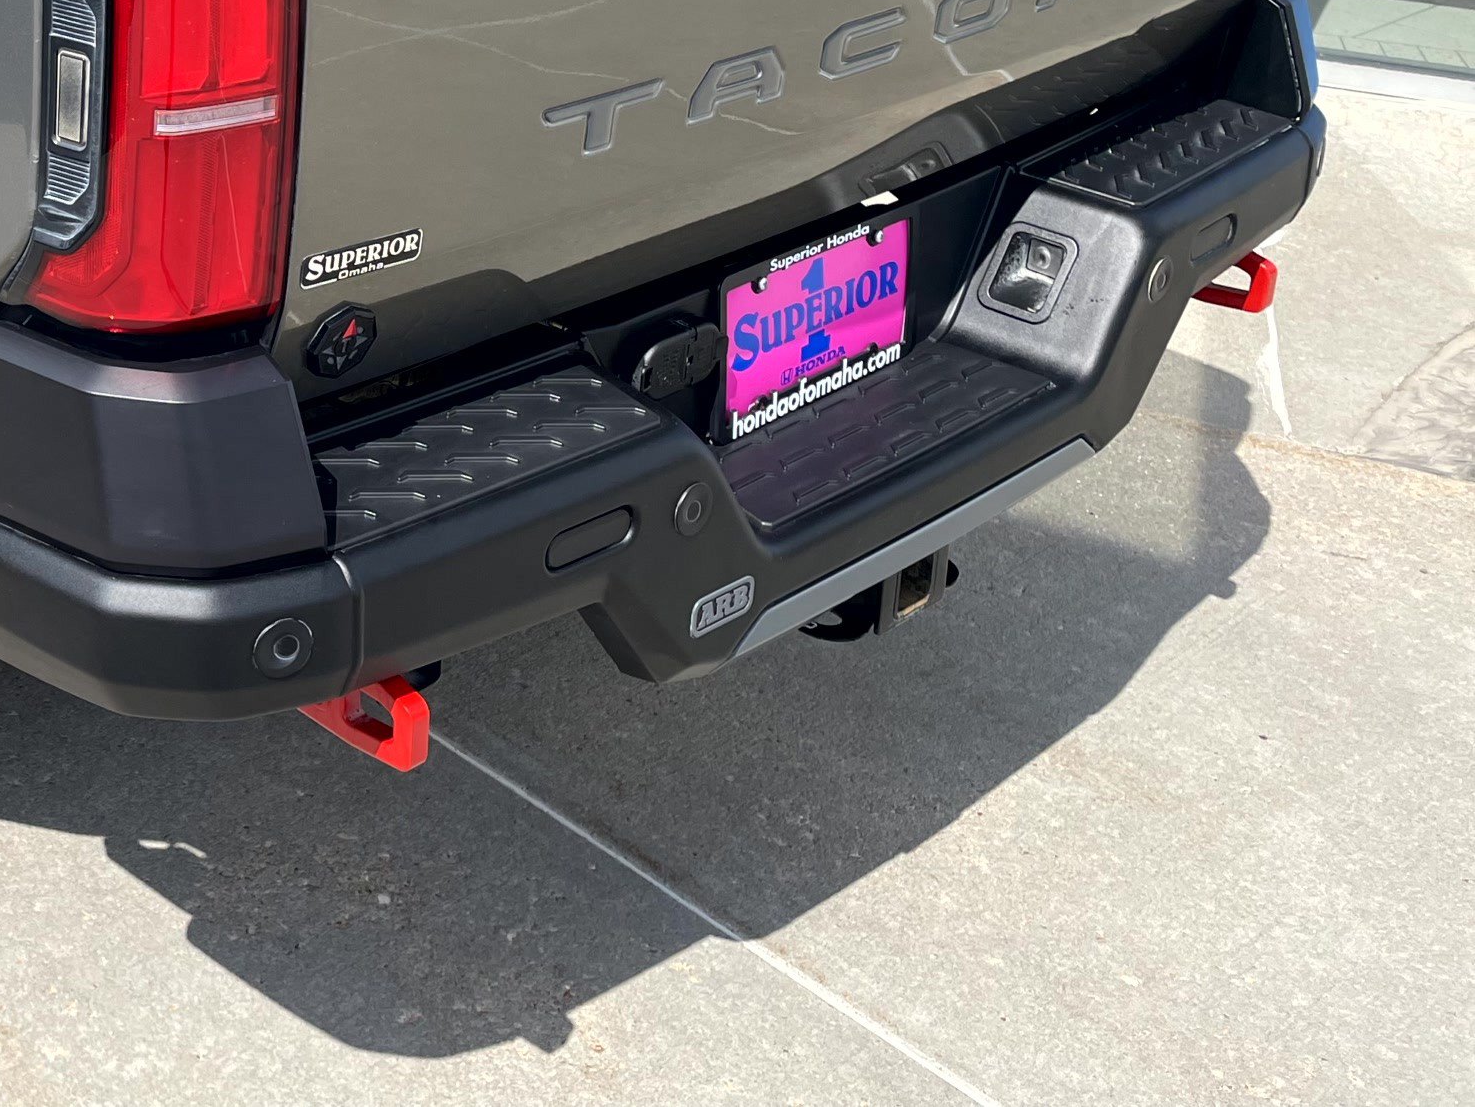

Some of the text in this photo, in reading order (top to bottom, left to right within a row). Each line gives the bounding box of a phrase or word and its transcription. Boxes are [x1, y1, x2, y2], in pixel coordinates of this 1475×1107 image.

[305, 233, 419, 281] SUPERIOR
[338, 262, 384, 280] Omaha
[770, 224, 870, 272] Superior Honda
[731, 261, 899, 372] SUPERIOR
[795, 345, 845, 377] HONDA
[732, 342, 901, 440] hondaofomaha.com
[696, 584, 749, 631] ARB
